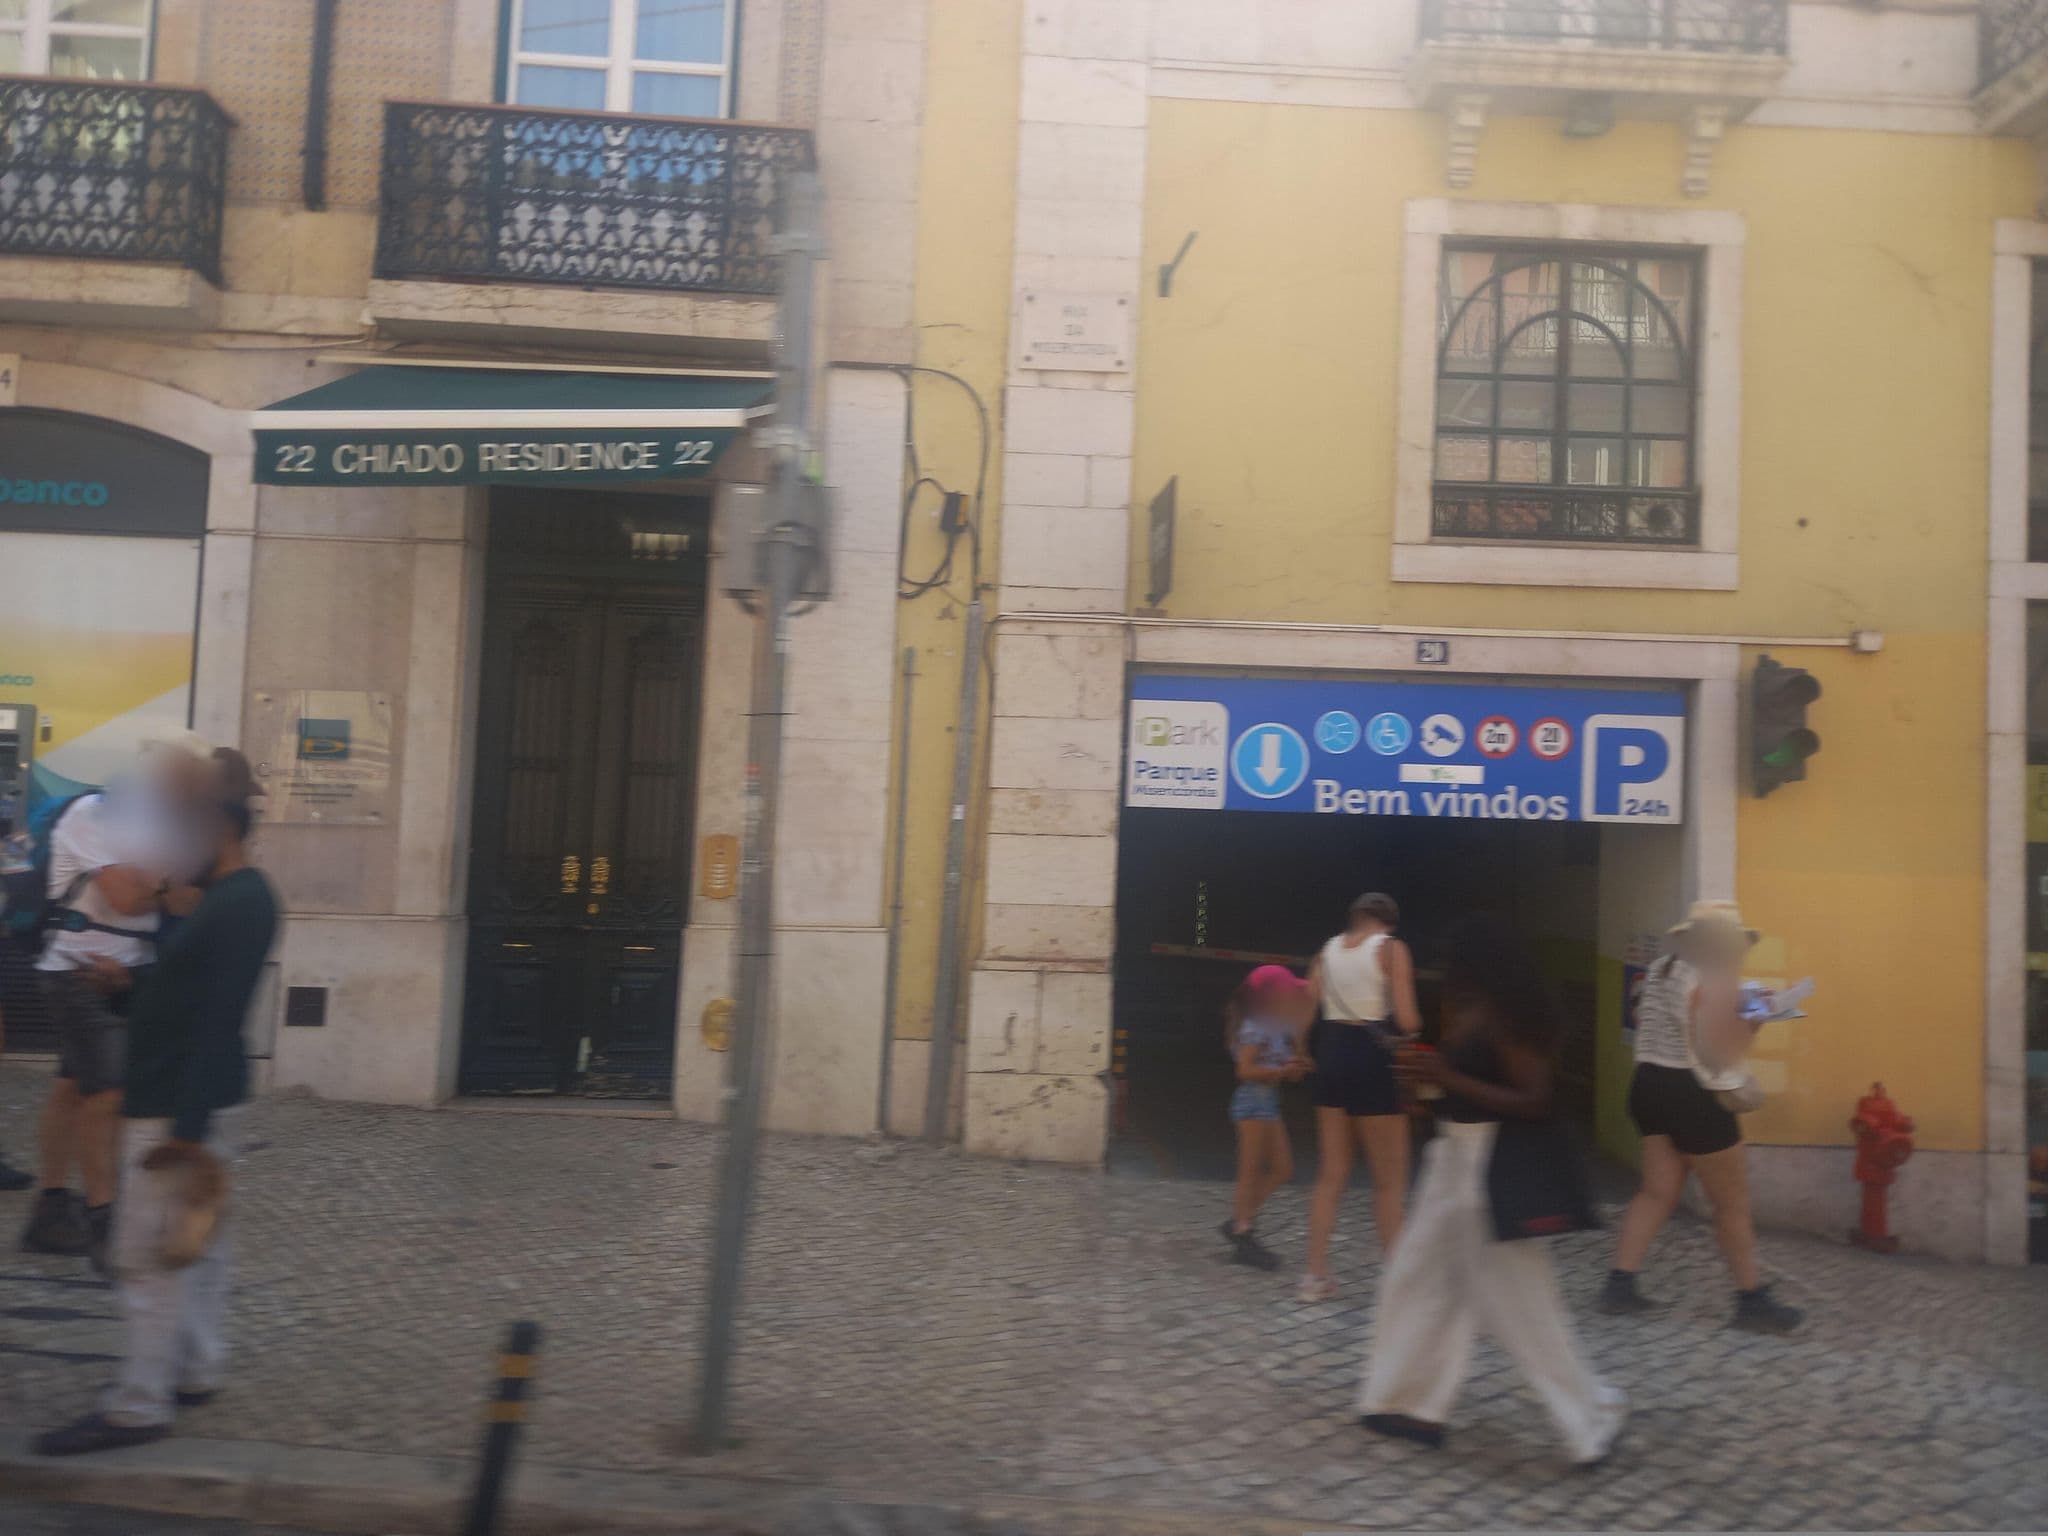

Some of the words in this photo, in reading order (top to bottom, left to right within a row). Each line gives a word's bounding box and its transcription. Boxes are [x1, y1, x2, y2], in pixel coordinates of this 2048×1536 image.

[275, 444, 316, 473] 22
[332, 442, 464, 474] CHIADO
[478, 441, 660, 472] RESIDENCE
[673, 441, 714, 466] 22
[1134, 716, 1218, 747] iPark
[1133, 759, 1217, 785] Parque
[1594, 727, 1668, 815] P
[1312, 778, 1412, 816] Bem
[1421, 783, 1569, 821] vindos
[1623, 798, 1668, 817] 24h
